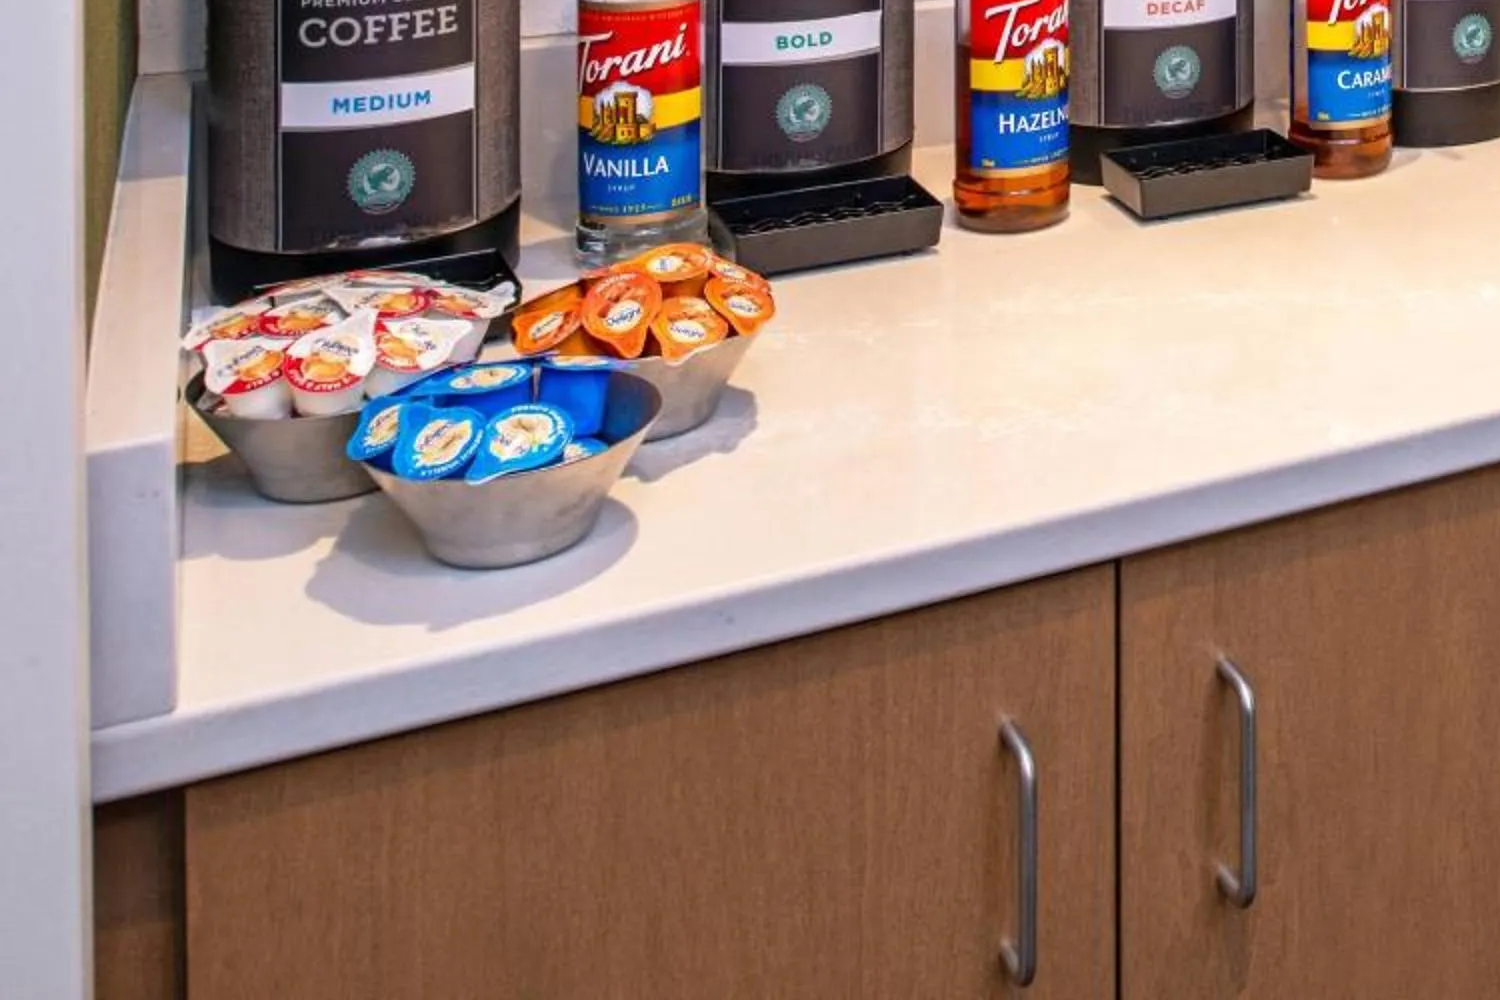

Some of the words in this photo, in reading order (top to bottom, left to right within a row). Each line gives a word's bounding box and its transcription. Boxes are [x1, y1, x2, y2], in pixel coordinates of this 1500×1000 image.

[298, 4, 459, 48] COFFEE
[775, 31, 834, 51] BOLD
[578, 21, 688, 95] Torani
[331, 89, 432, 115] MEDIUM
[998, 107, 1068, 135] HAZELN
[583, 151, 670, 178] VANILLA
